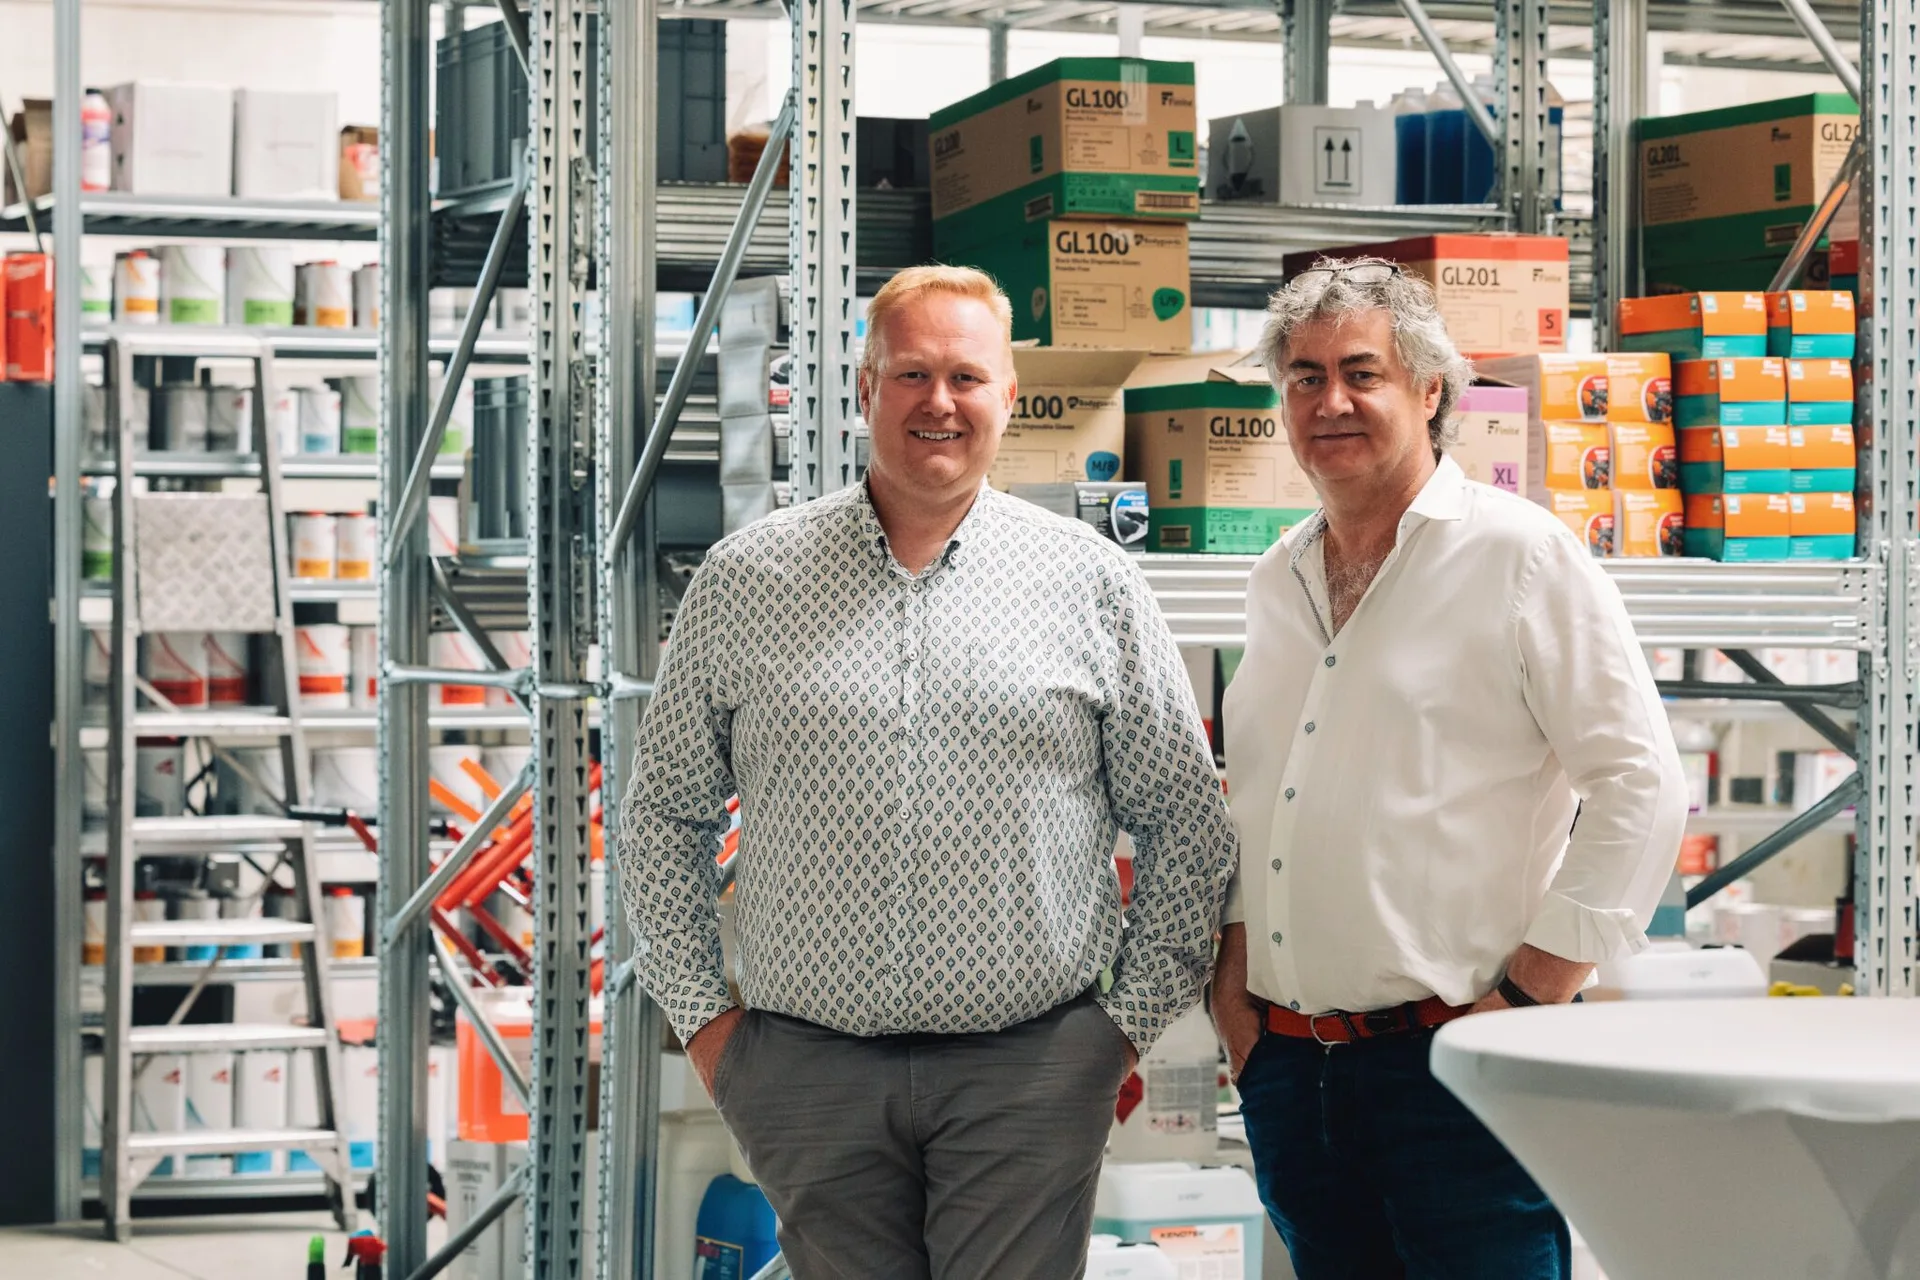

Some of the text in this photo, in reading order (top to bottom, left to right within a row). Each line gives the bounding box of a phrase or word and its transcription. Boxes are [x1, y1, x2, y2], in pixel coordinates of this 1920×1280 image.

[1066, 88, 1128, 109] GL100
[1176, 136, 1186, 153] L
[1056, 230, 1129, 255] GL100
[1442, 266, 1500, 286] GL201
[1545, 313, 1554, 330] S
[1010, 395, 1063, 419] 100
[1210, 416, 1275, 438] GL100
[1494, 468, 1516, 485] XL
